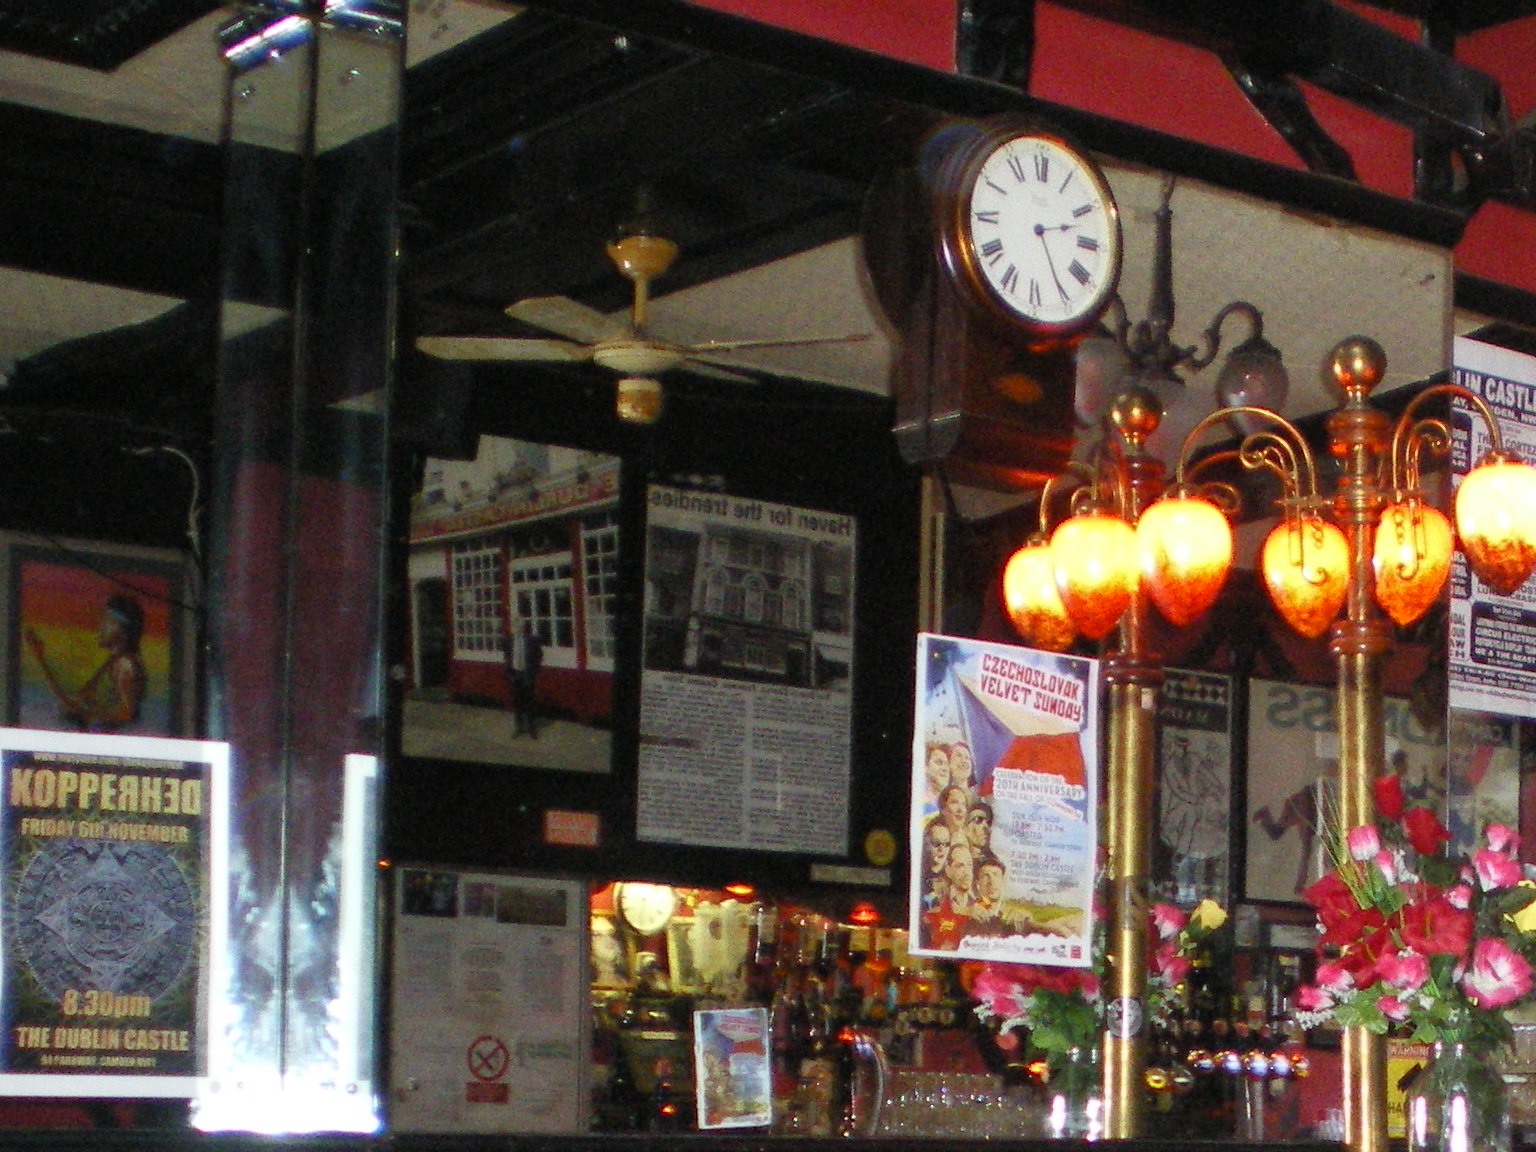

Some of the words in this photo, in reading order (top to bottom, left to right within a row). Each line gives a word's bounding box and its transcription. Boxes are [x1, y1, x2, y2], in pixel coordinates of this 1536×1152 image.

[982, 652, 1079, 701] CZECHOSLOVAK
[980, 673, 1032, 705] VELVET
[1033, 690, 1082, 723] SUNDAY
[996, 778, 1018, 790] 20TH
[1020, 781, 1082, 798] ANNIVERSARY
[20, 817, 76, 838] FRIDAY
[105, 821, 190, 843] NOVEMBER
[62, 988, 151, 1018] 8.30pm
[16, 1026, 50, 1048] THE
[54, 1026, 119, 1050] DUBLIN
[123, 1028, 190, 1051] CASTLE
